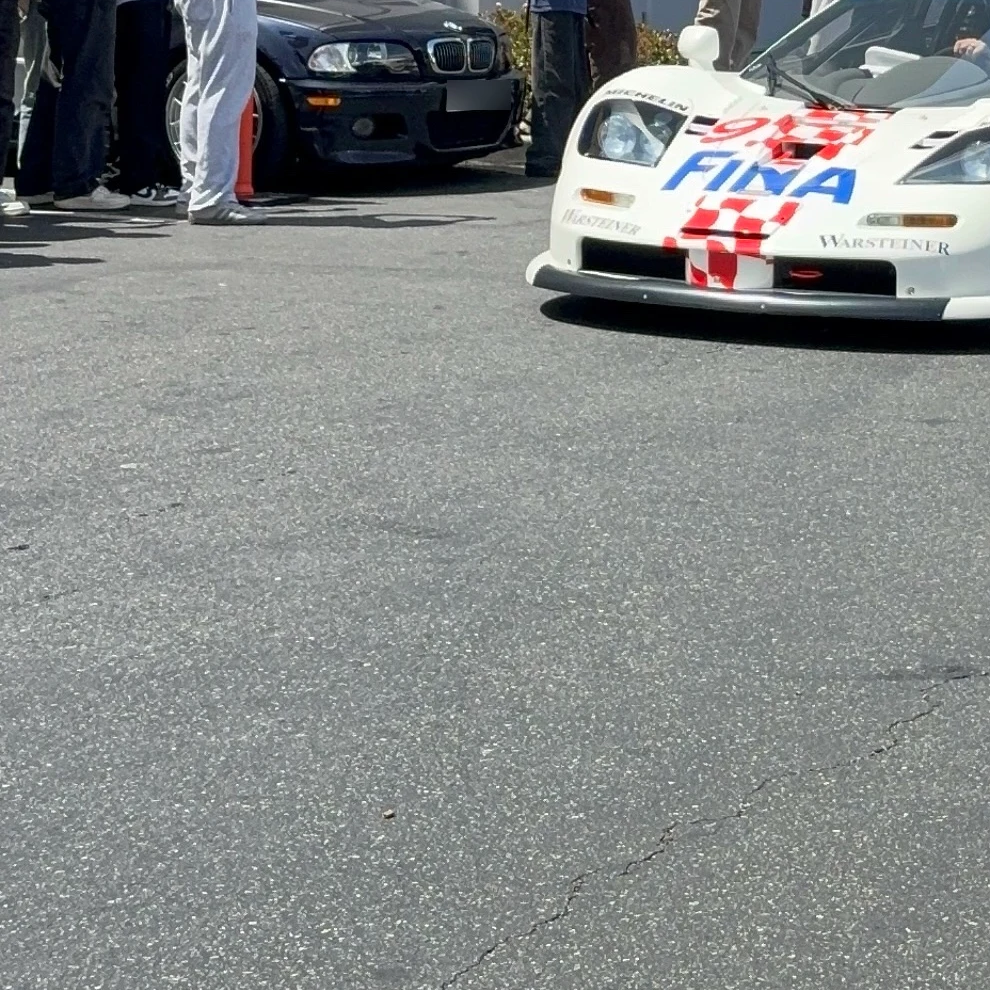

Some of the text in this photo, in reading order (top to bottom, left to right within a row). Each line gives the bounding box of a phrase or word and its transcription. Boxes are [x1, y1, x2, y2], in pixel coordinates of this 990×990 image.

[605, 89, 688, 111] MICHELIN
[660, 150, 857, 204] FINA
[819, 234, 950, 256] WARSTEINER
